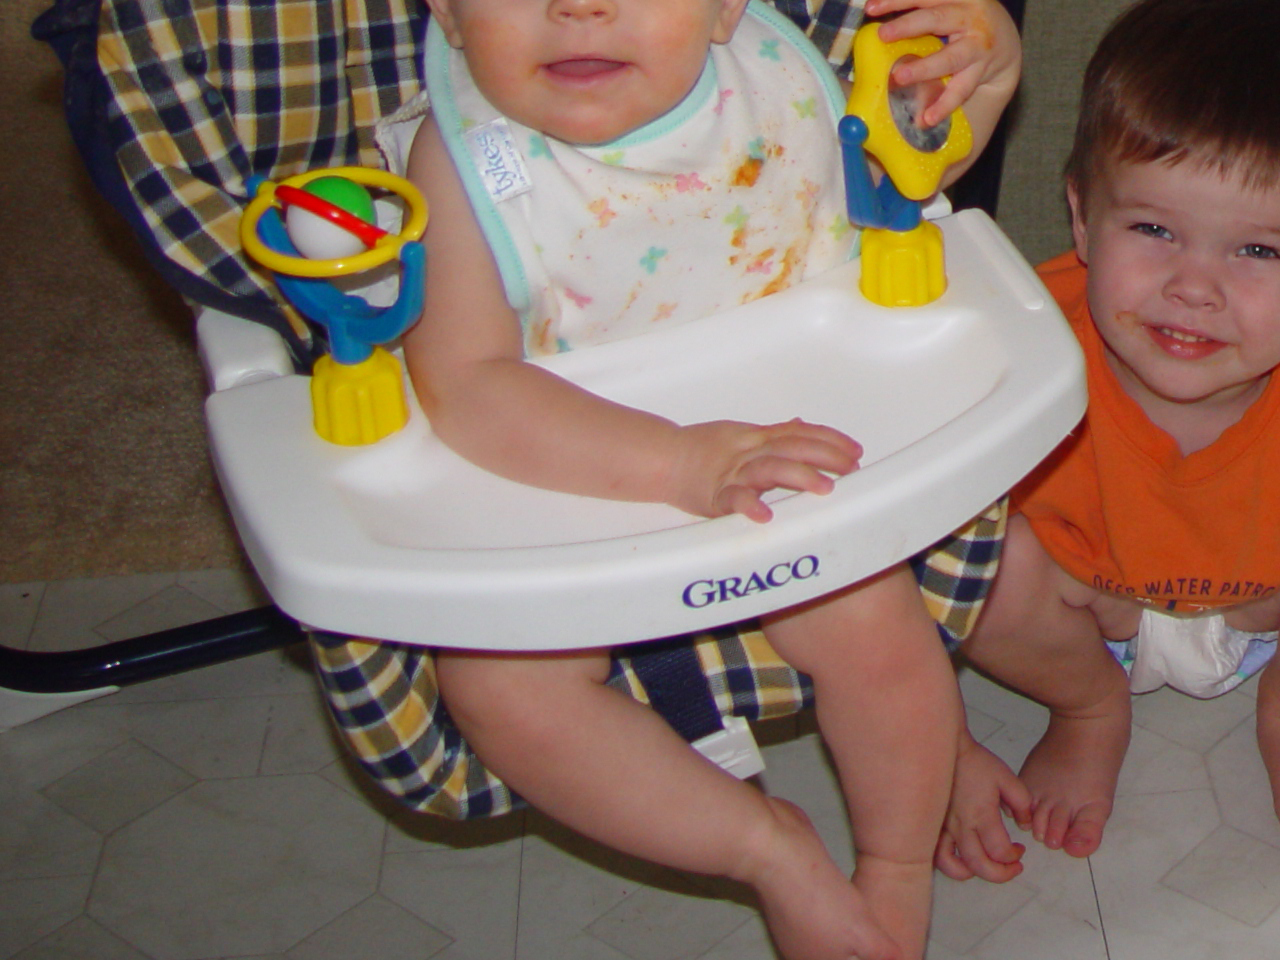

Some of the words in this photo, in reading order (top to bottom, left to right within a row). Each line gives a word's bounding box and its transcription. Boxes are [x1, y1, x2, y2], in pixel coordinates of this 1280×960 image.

[475, 131, 517, 195] tykes
[681, 554, 820, 609] GRACO
[1144, 578, 1212, 596] WATER
